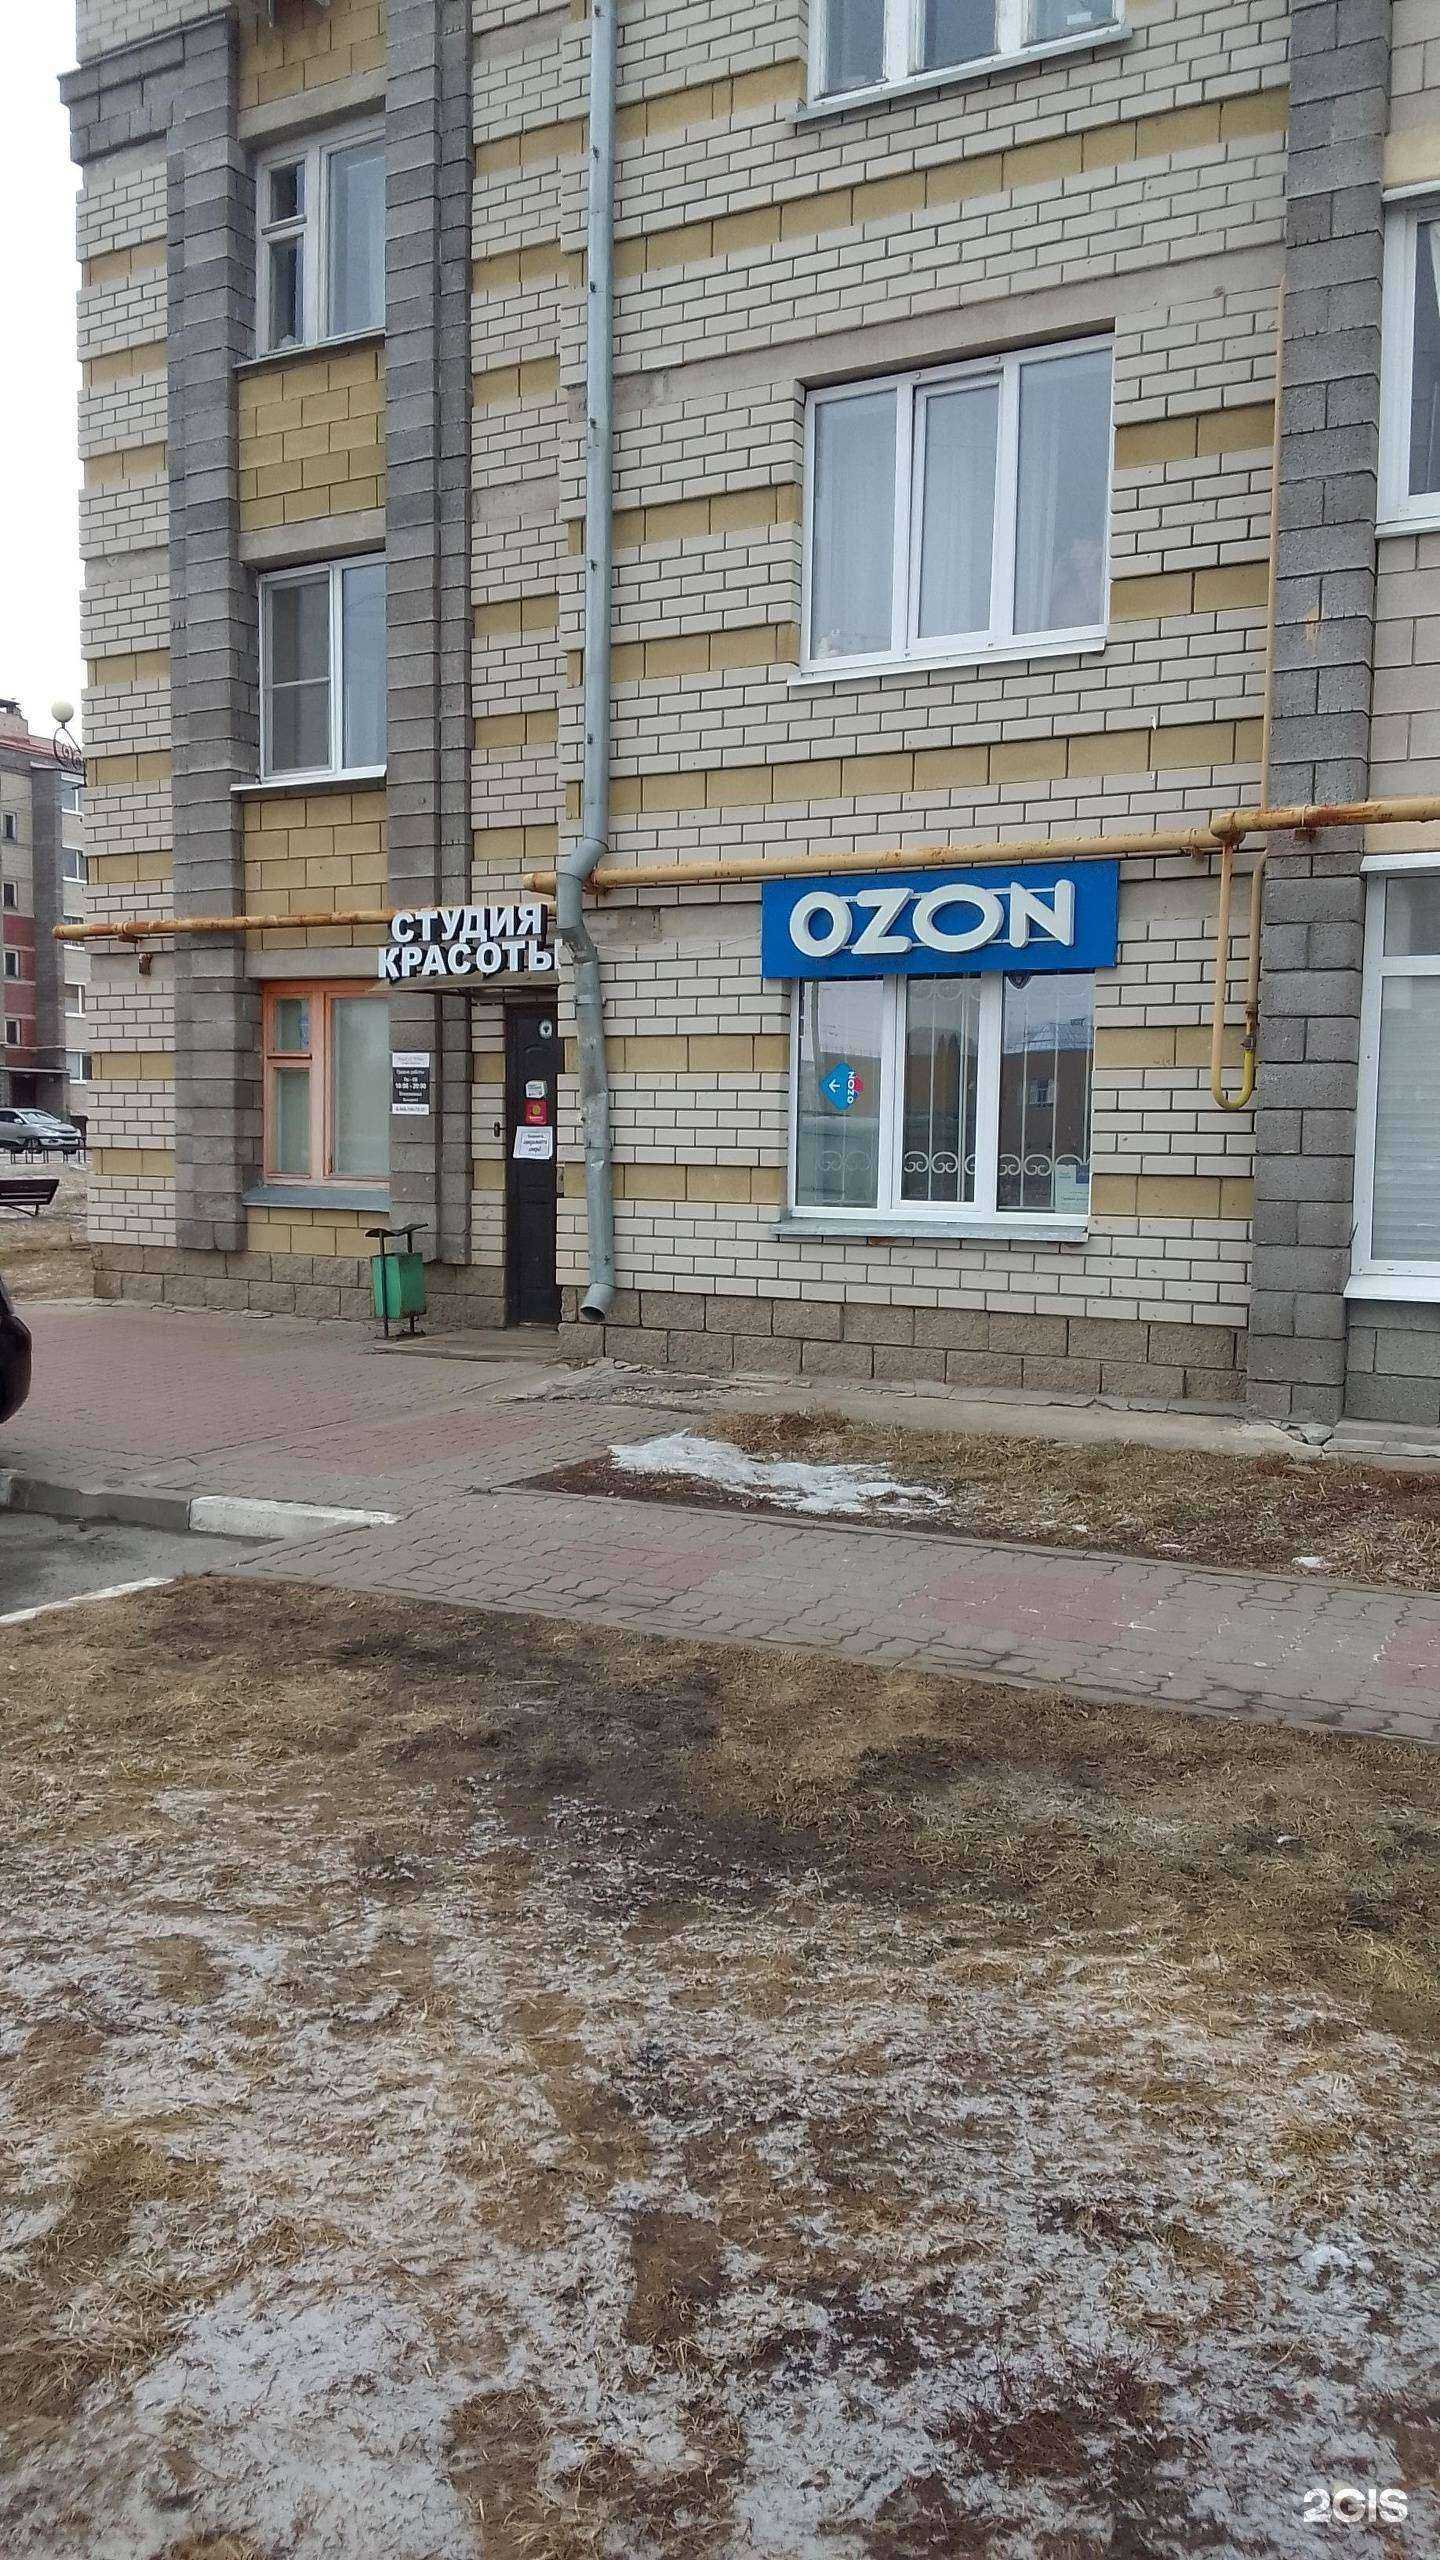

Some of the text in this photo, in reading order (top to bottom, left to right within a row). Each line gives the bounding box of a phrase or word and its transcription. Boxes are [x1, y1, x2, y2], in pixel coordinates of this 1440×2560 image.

[391, 902, 543, 943] СТУДИЯ
[789, 879, 1075, 957] OZON
[378, 938, 563, 979] КРАСОТЫ
[846, 1071, 855, 1104] OZON
